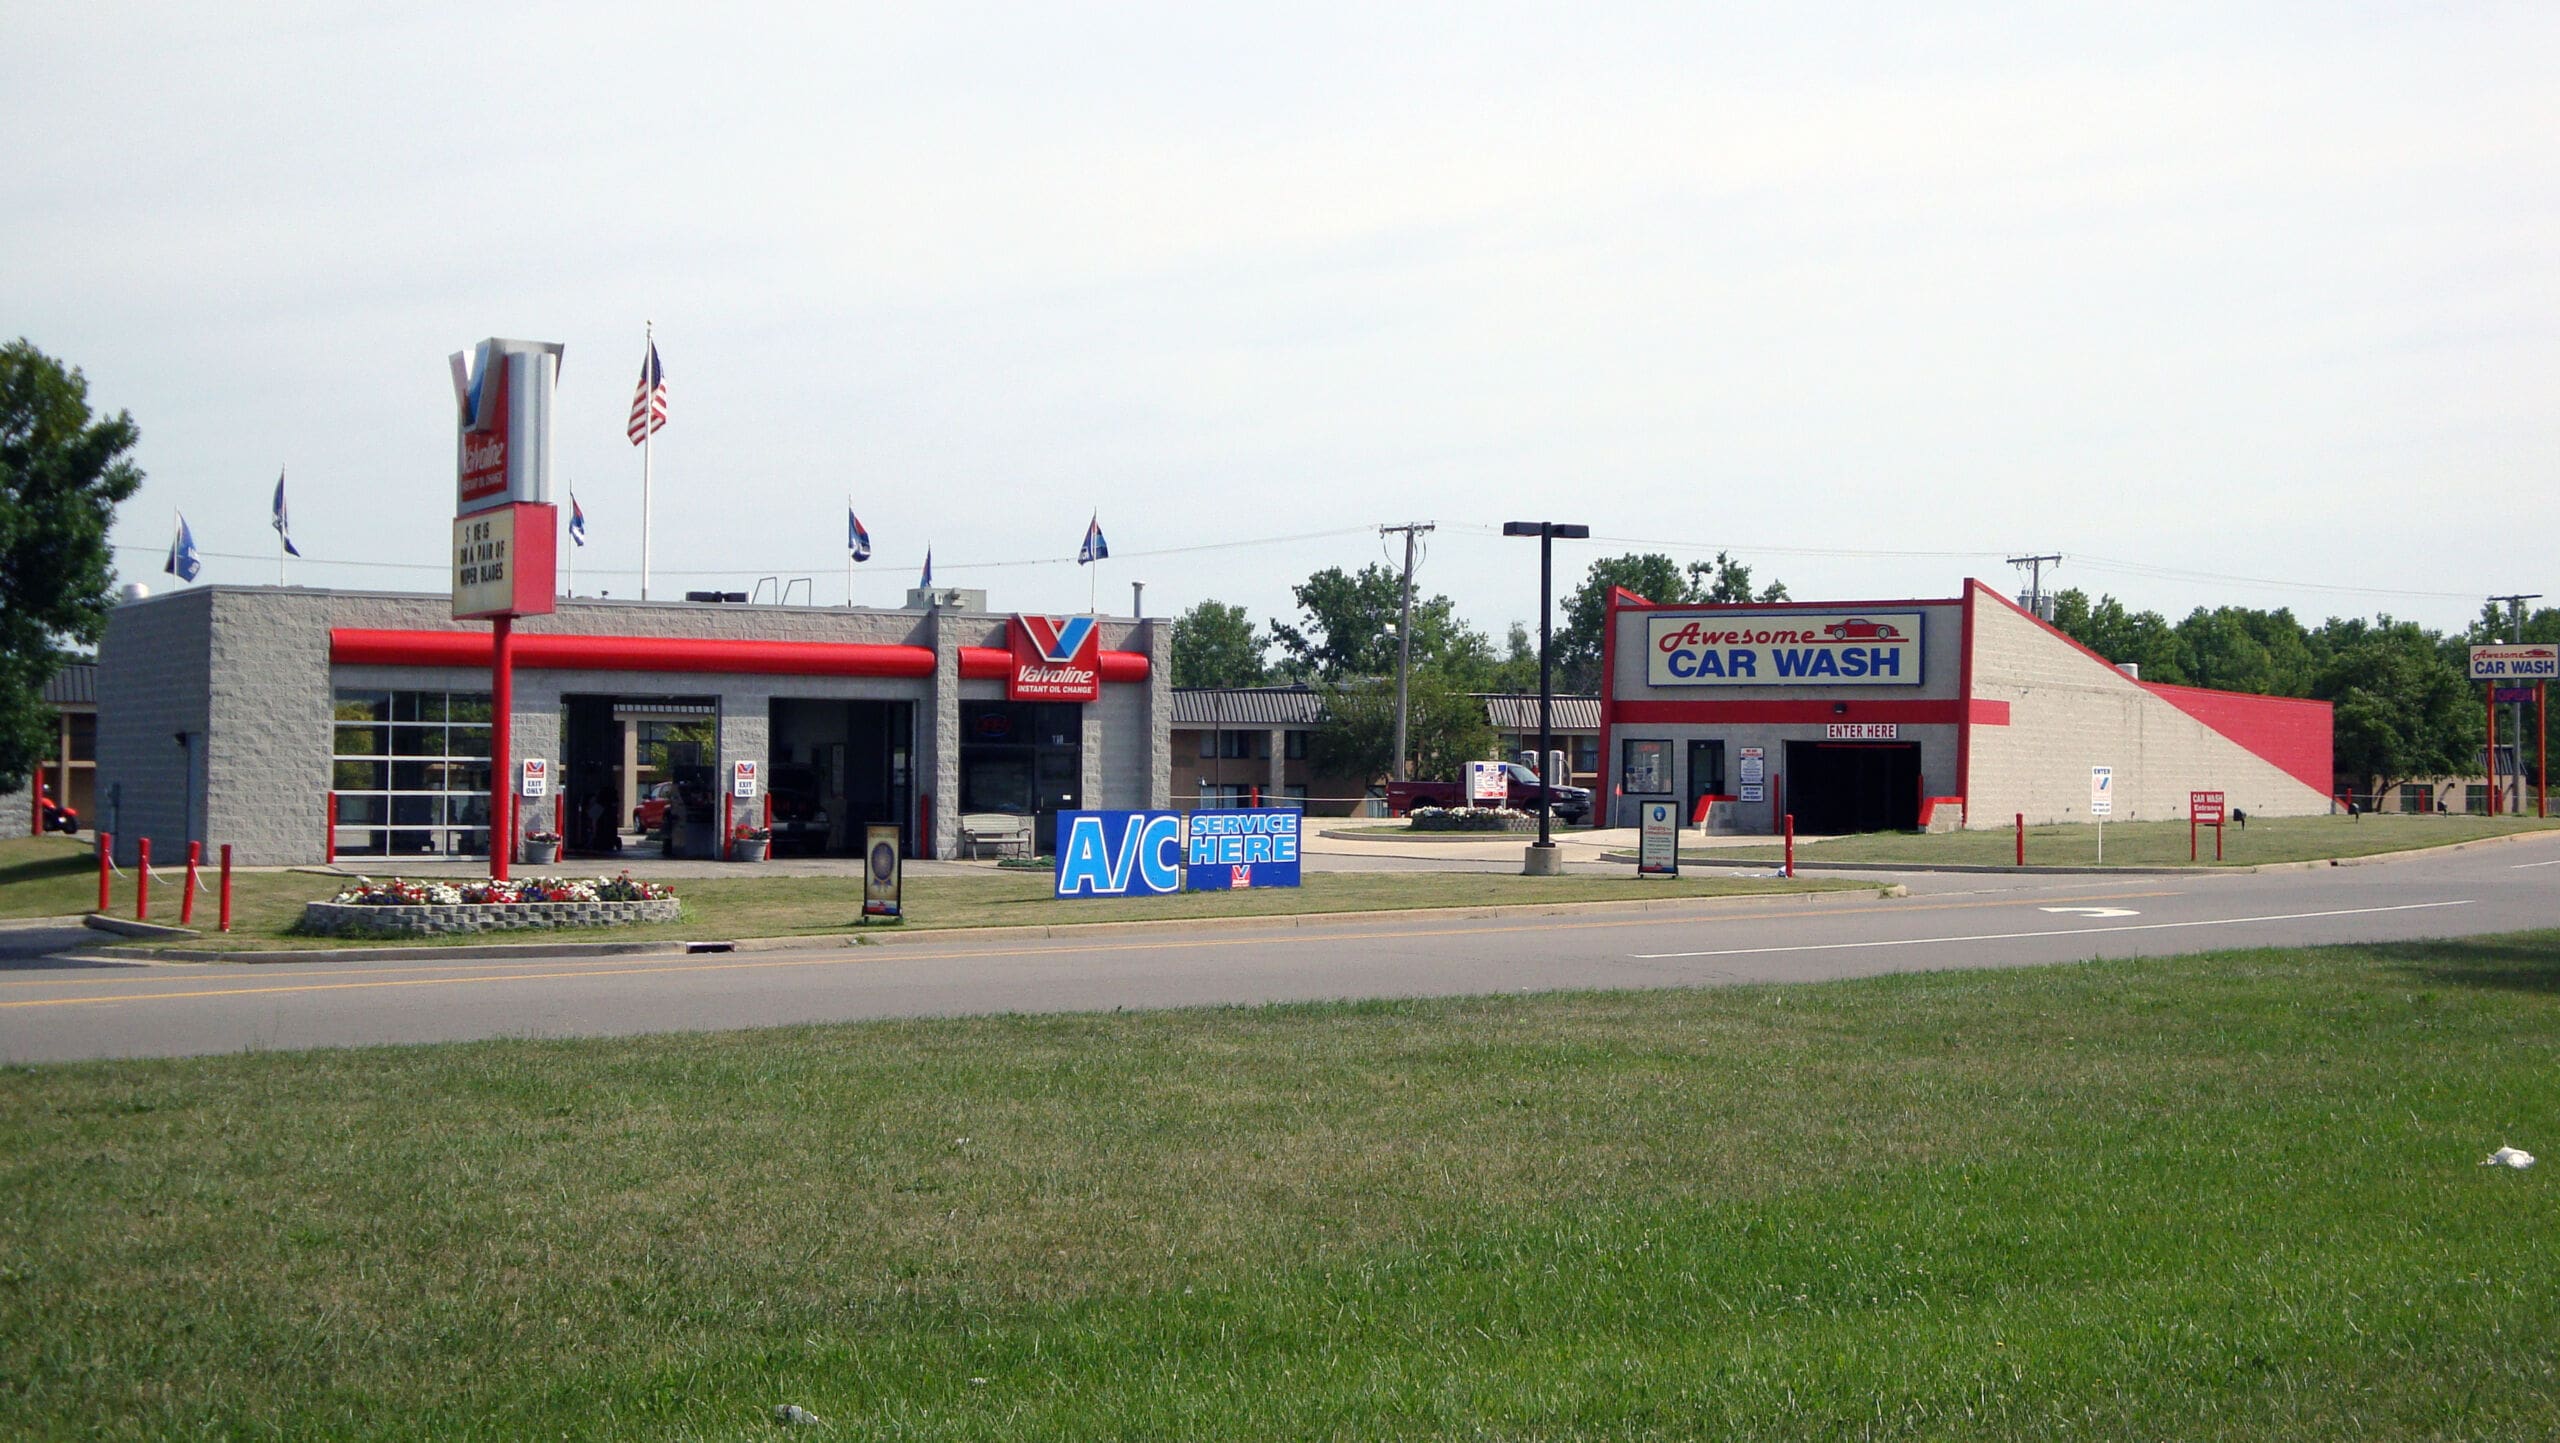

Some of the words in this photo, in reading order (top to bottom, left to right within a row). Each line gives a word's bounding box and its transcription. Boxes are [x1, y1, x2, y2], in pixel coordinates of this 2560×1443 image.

[469, 546, 474, 562] A
[478, 543, 493, 562] PAIR
[496, 540, 505, 559] OF
[481, 562, 503, 583] BLADES
[1659, 622, 1817, 652] Awesome
[1668, 649, 1757, 678] CAR
[1772, 648, 1900, 677] WASH
[2472, 649, 2526, 661] Awesome
[1018, 665, 1094, 684] Valvoline
[2475, 661, 2506, 674] CAR
[2511, 660, 2554, 674] WASH
[1017, 685, 1049, 693] INSTANT
[1829, 725, 1863, 738] ENTER
[1867, 725, 1894, 738] HERE
[526, 787, 543, 795] ONLY
[2193, 794, 2205, 803] CAR
[2207, 794, 2222, 803] WASH
[1191, 814, 1297, 835] SERVICE
[1059, 815, 1180, 894] A/C
[1189, 835, 1297, 864] HERE
